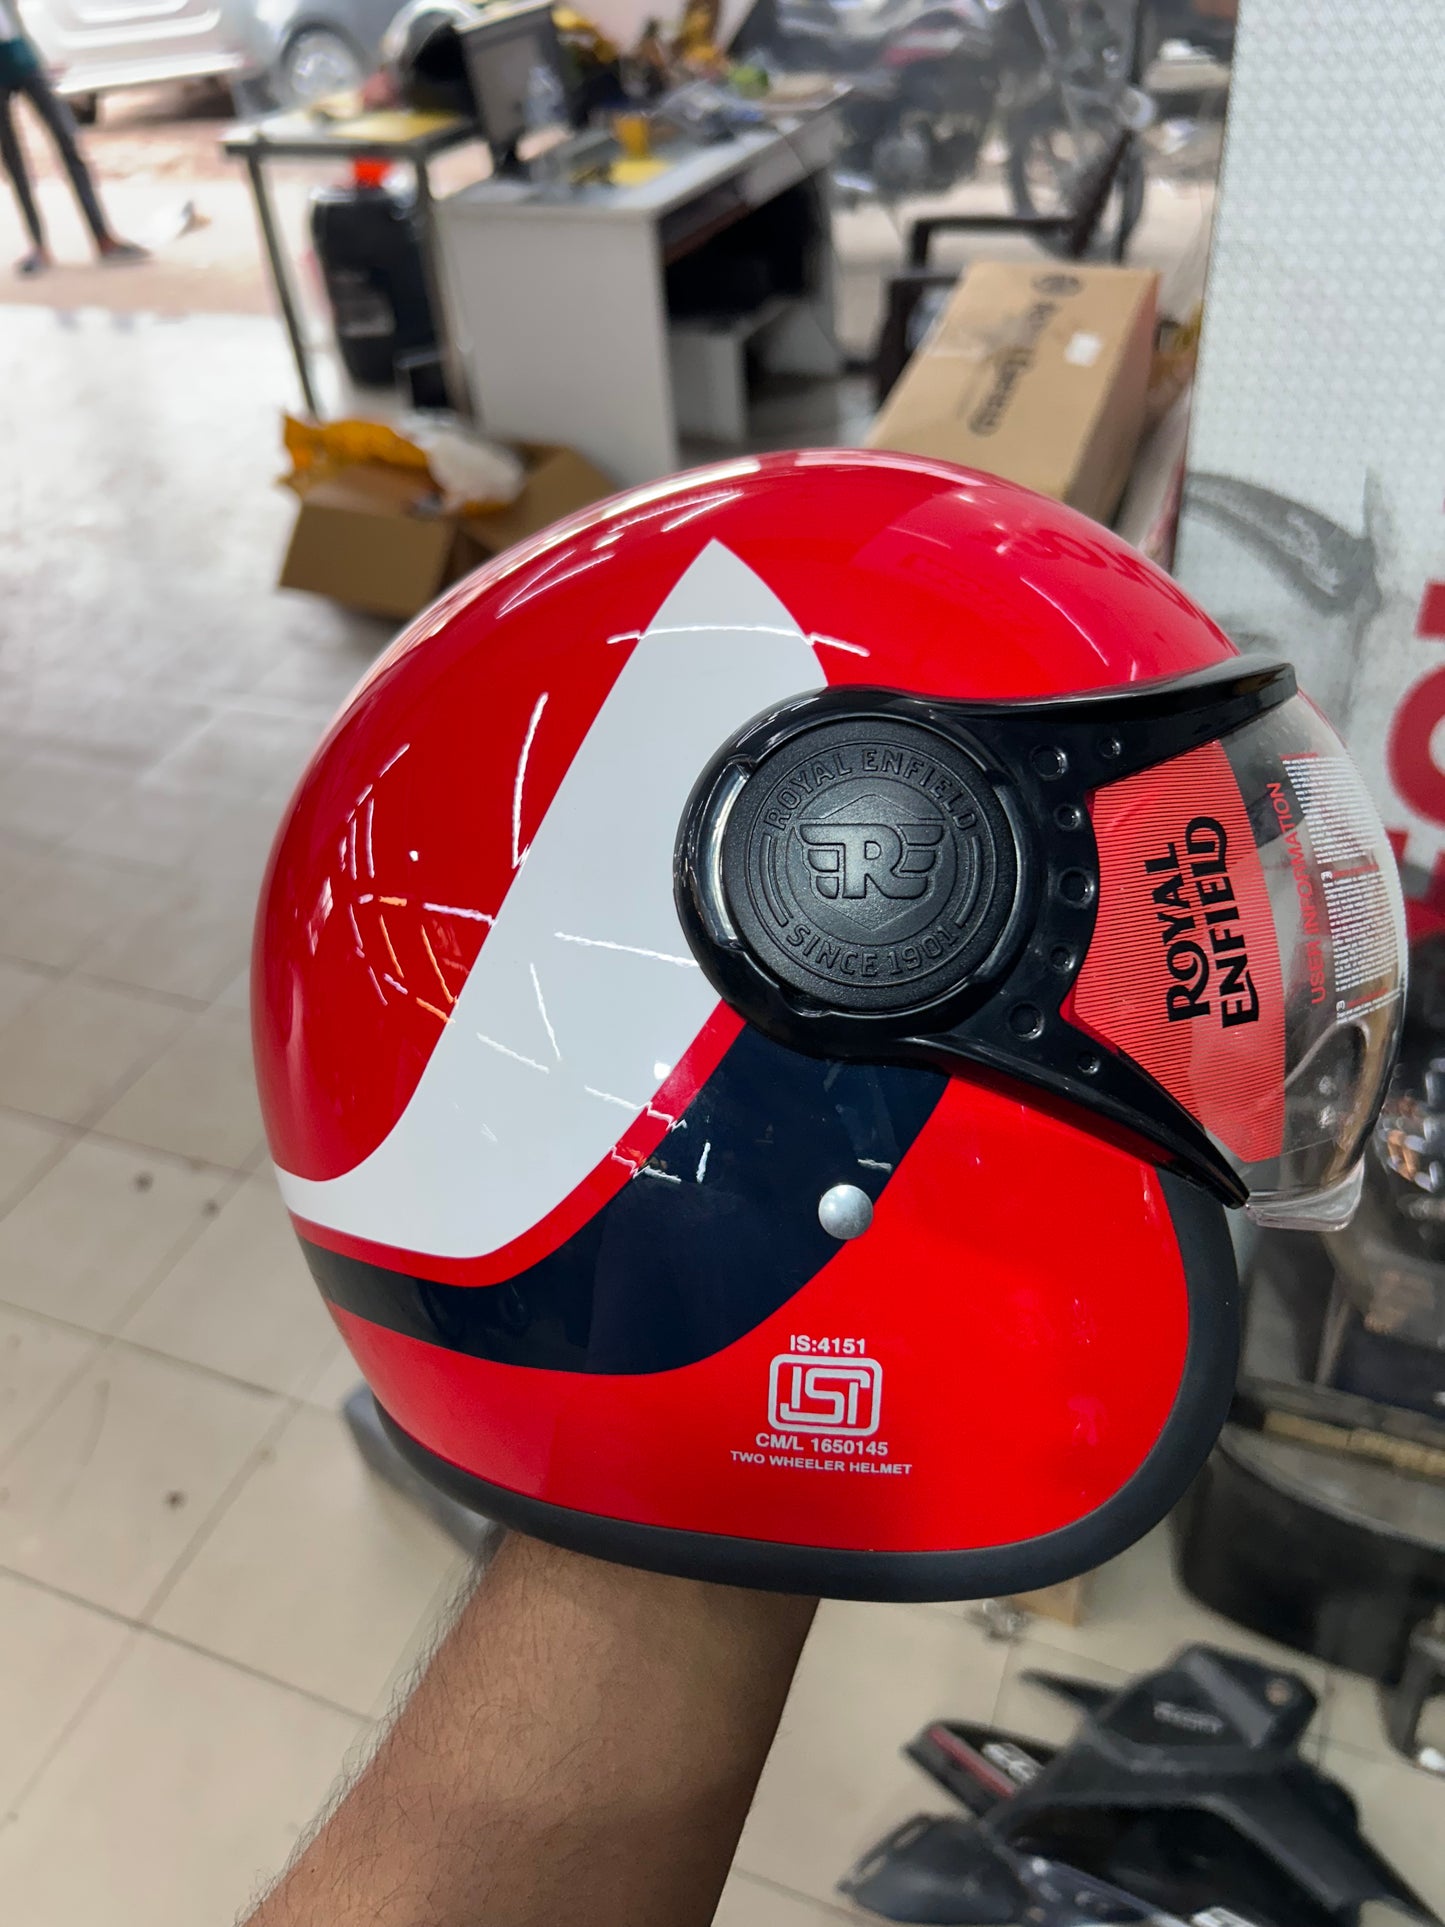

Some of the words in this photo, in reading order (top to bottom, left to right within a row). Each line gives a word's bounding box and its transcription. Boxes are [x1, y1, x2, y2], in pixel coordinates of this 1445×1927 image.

[764, 754, 852, 830] ROYAL
[862, 749, 980, 831] ENFIELD
[1266, 782, 1320, 935] INFORMATION
[786, 923, 878, 977] SINCE
[887, 924, 959, 975] 1901
[1144, 842, 1211, 1022] ROYAL
[1185, 816, 1260, 1028] ENFIELD
[1306, 939, 1327, 1004] USER
[790, 1334, 866, 1354] IS:4151
[730, 1450, 766, 1465] TWO
[769, 1455, 846, 1472] WHEELER
[849, 1462, 913, 1475] HELMET
[755, 1432, 804, 1451] CM/L
[810, 1437, 889, 1456] 1650145
